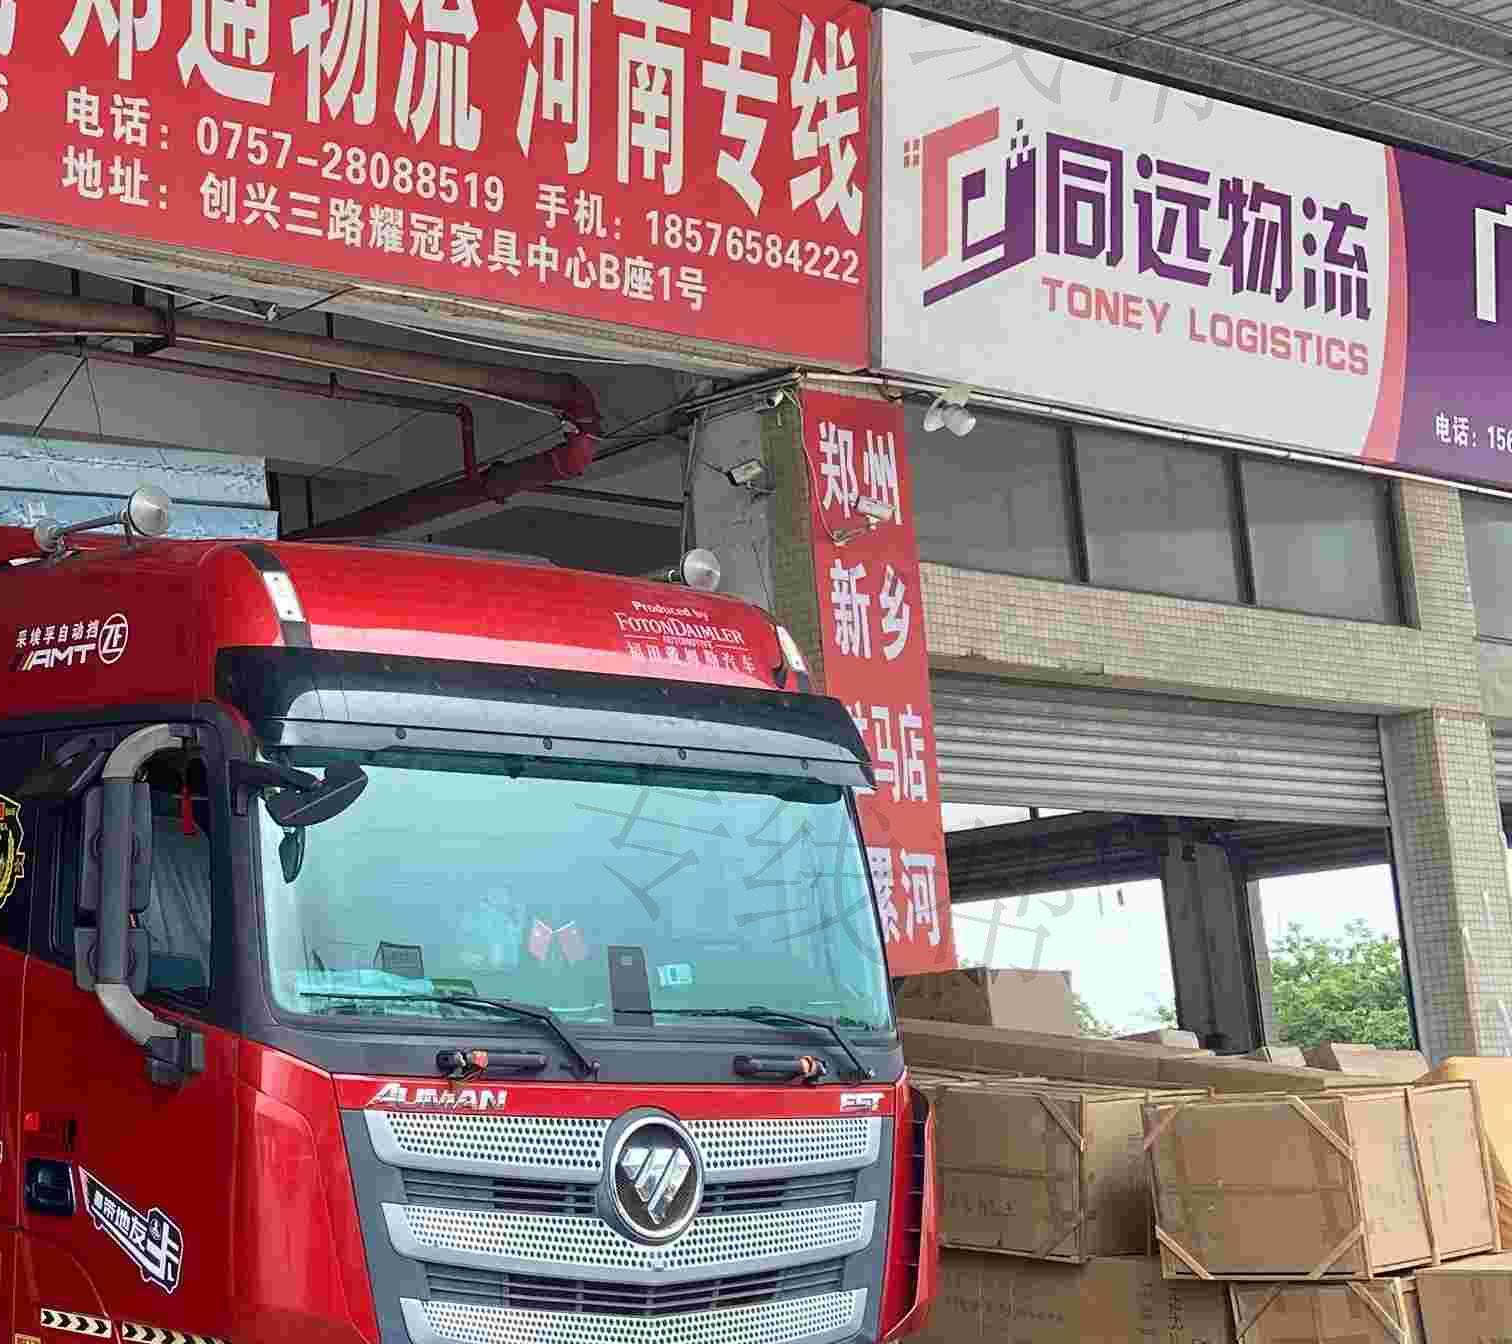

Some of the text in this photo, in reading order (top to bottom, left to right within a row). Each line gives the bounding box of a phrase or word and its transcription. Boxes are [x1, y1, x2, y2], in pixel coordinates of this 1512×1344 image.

[1045, 130, 1372, 321] 同远物流
[1041, 276, 1369, 376] TONEY LOGISTICS
[819, 420, 904, 526] 郑州
[100, 619, 128, 659] ZF
[829, 557, 911, 661] 新乡
